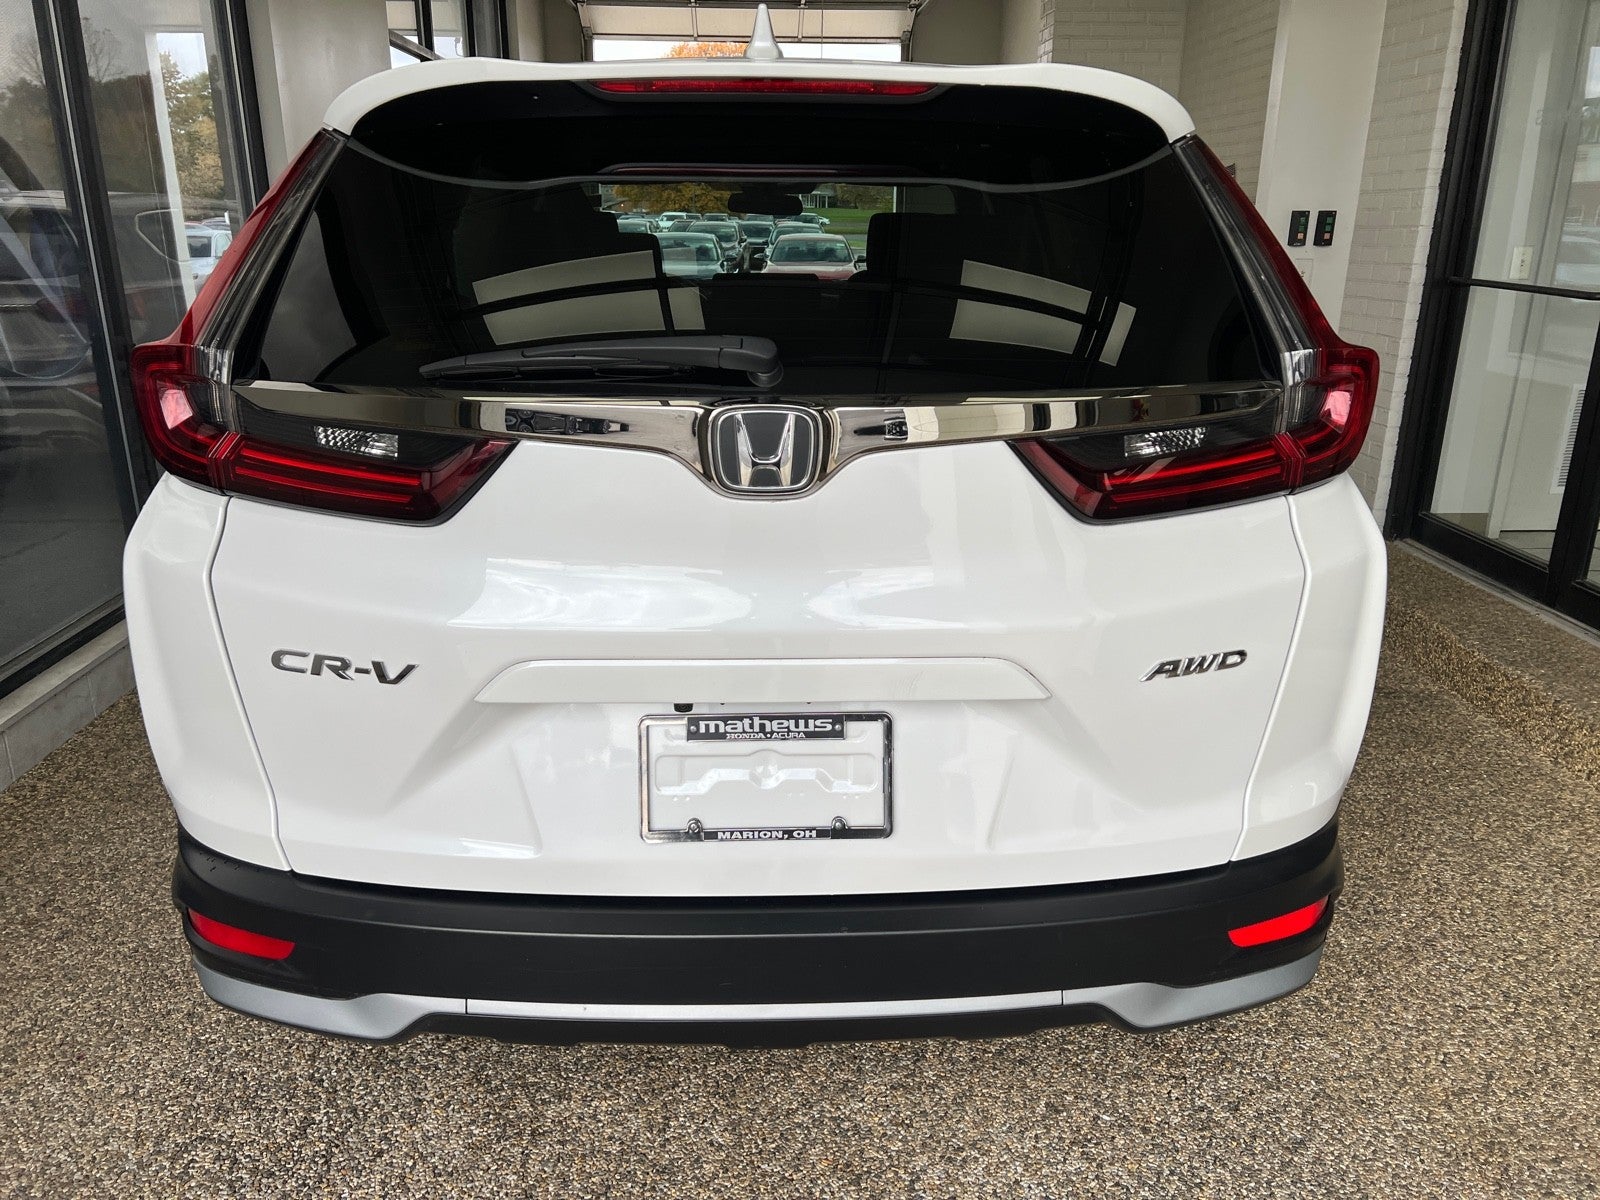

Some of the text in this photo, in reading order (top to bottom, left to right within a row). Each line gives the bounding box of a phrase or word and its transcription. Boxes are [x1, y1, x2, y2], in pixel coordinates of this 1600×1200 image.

[271, 649, 419, 685] CR-V
[1140, 649, 1248, 682] AWD
[699, 716, 833, 734] mathews
[717, 829, 817, 840] MARION, OH
